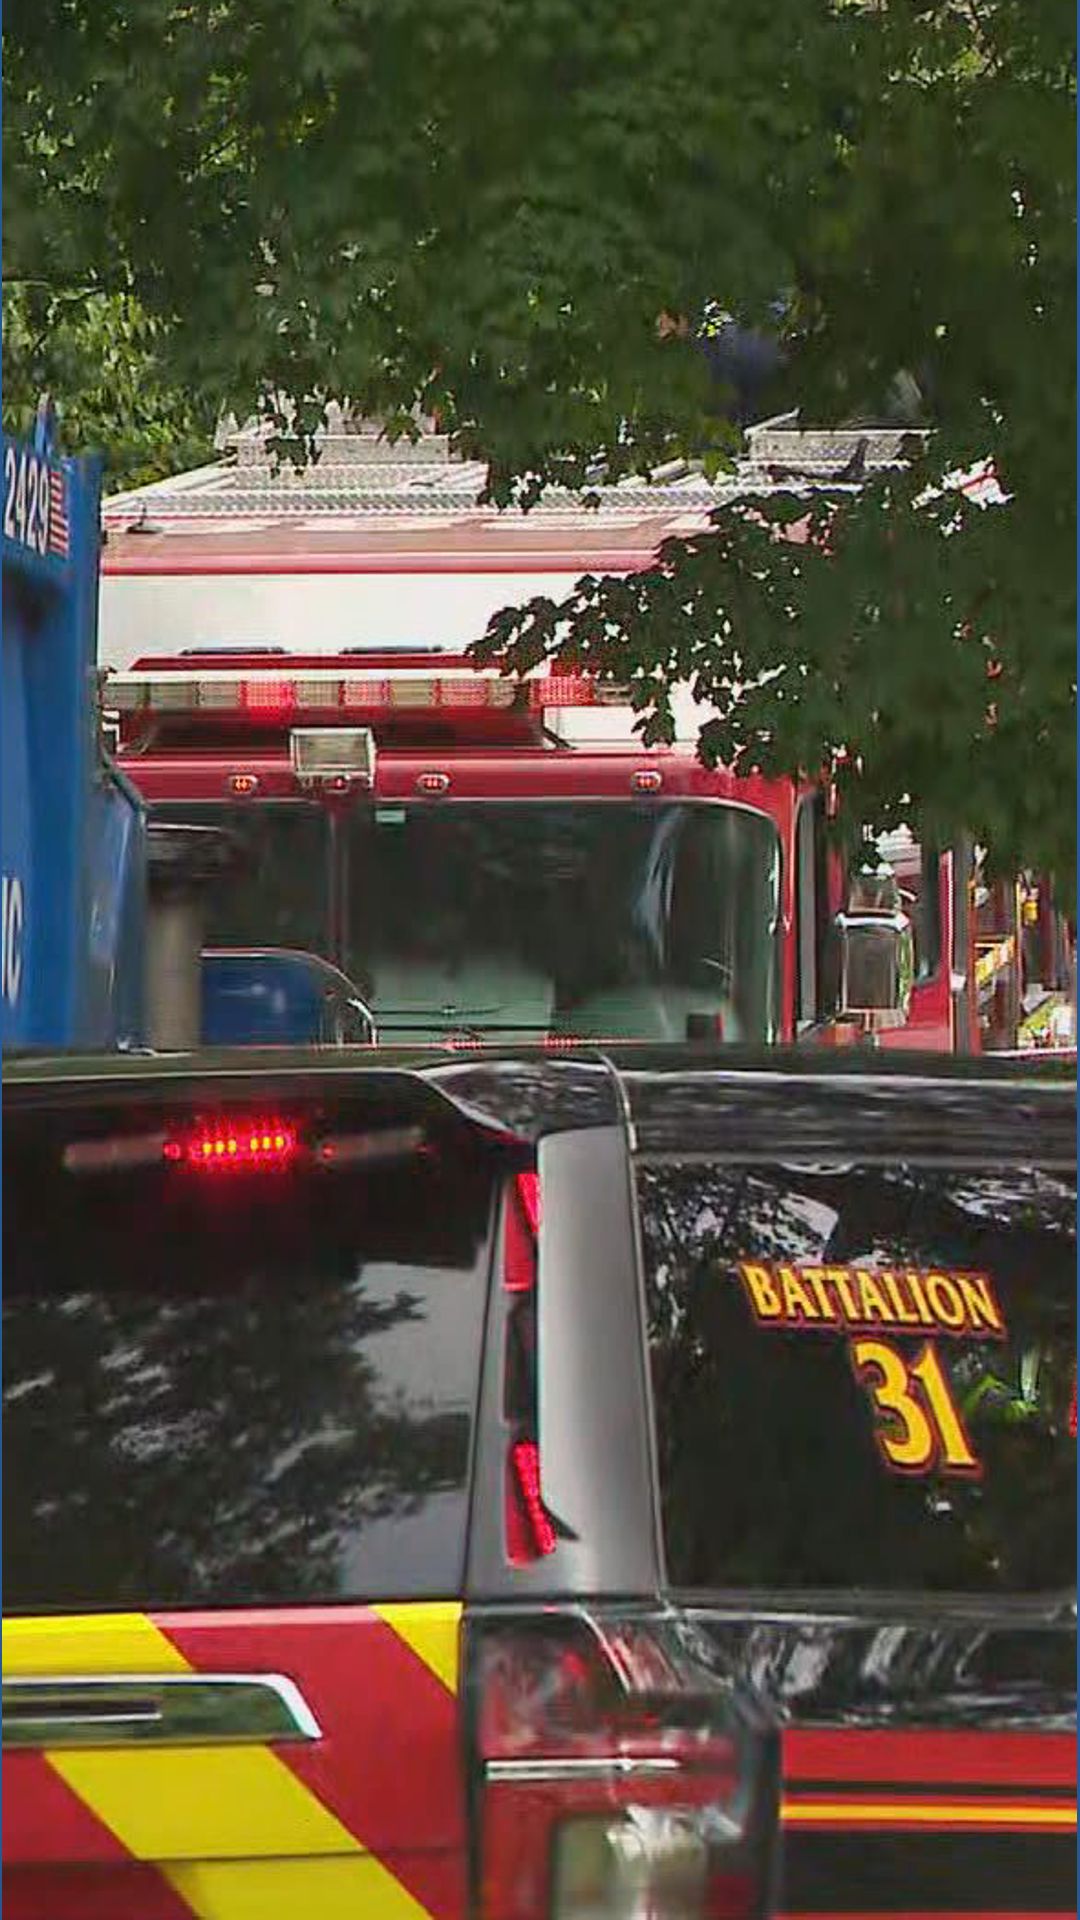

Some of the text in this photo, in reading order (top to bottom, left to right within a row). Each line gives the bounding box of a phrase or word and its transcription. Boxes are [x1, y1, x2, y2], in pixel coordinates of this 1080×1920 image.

[4, 447, 49, 556] 2429
[739, 1262, 1005, 1337] BATTALION
[851, 1339, 982, 1474] 31
